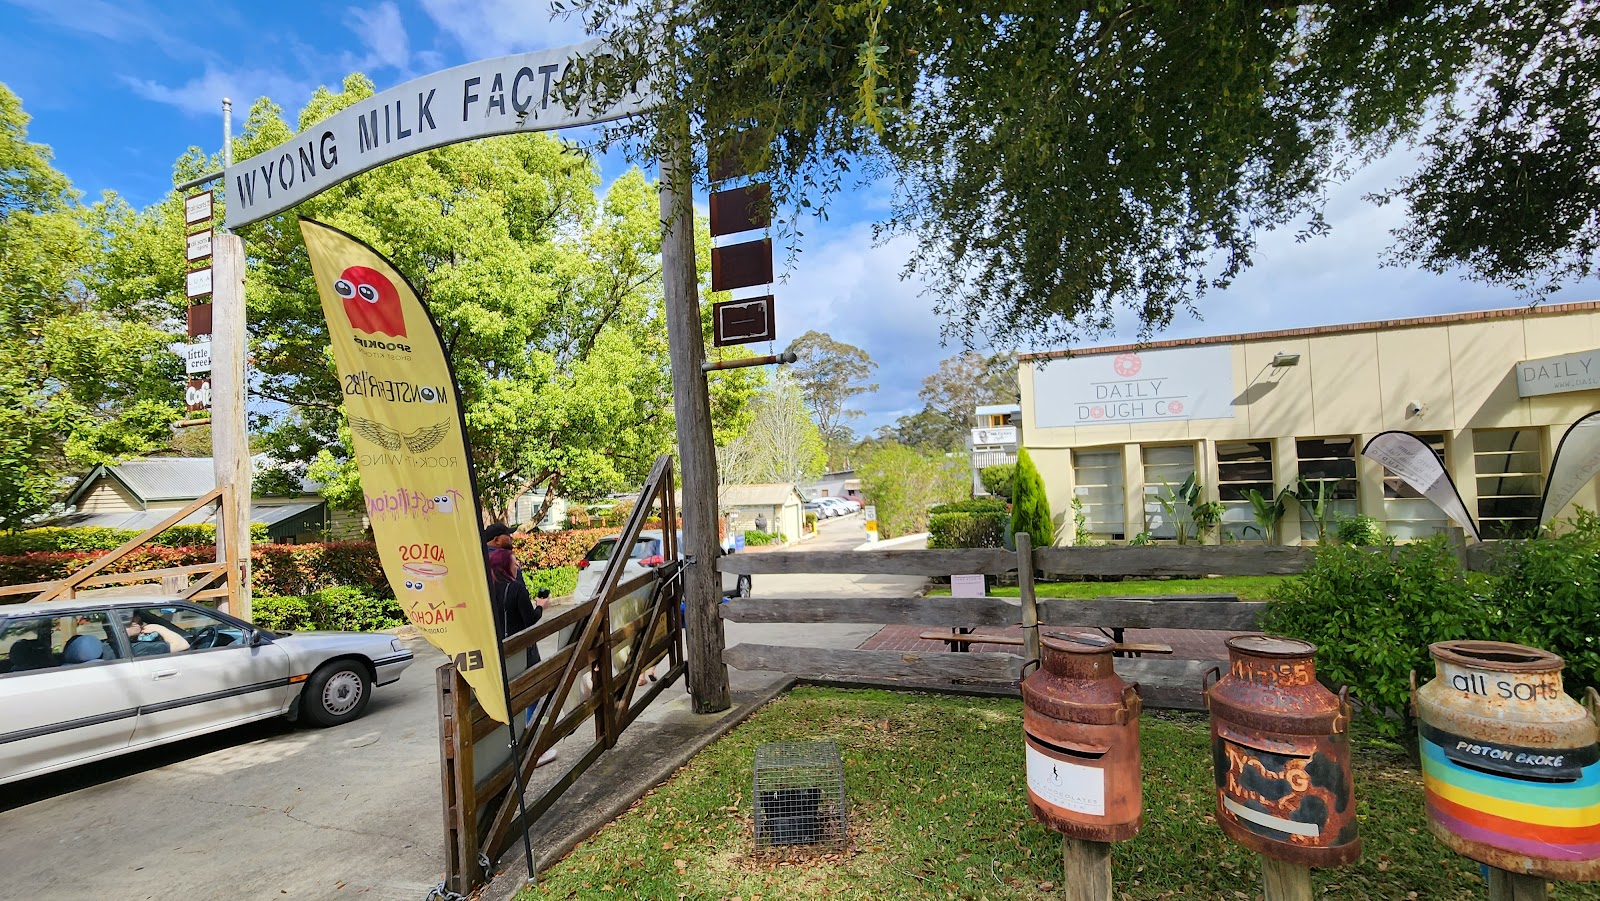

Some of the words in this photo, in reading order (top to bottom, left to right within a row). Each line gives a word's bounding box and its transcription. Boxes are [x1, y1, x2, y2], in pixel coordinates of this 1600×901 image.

[237, 131, 338, 209] WYONG
[358, 88, 437, 153] MILK
[463, 53, 642, 121] FACTO
[188, 349, 208, 359] little
[1523, 358, 1592, 382] DAILY
[1096, 381, 1162, 399] DAILY
[1078, 402, 1144, 420] DOUGH
[1452, 673, 1488, 696] all
[1496, 679, 1559, 701] sorts
[1456, 741, 1514, 762] PISTON
[1515, 752, 1564, 767] BROKE
[1043, 785, 1098, 804] CHOCOLATES
